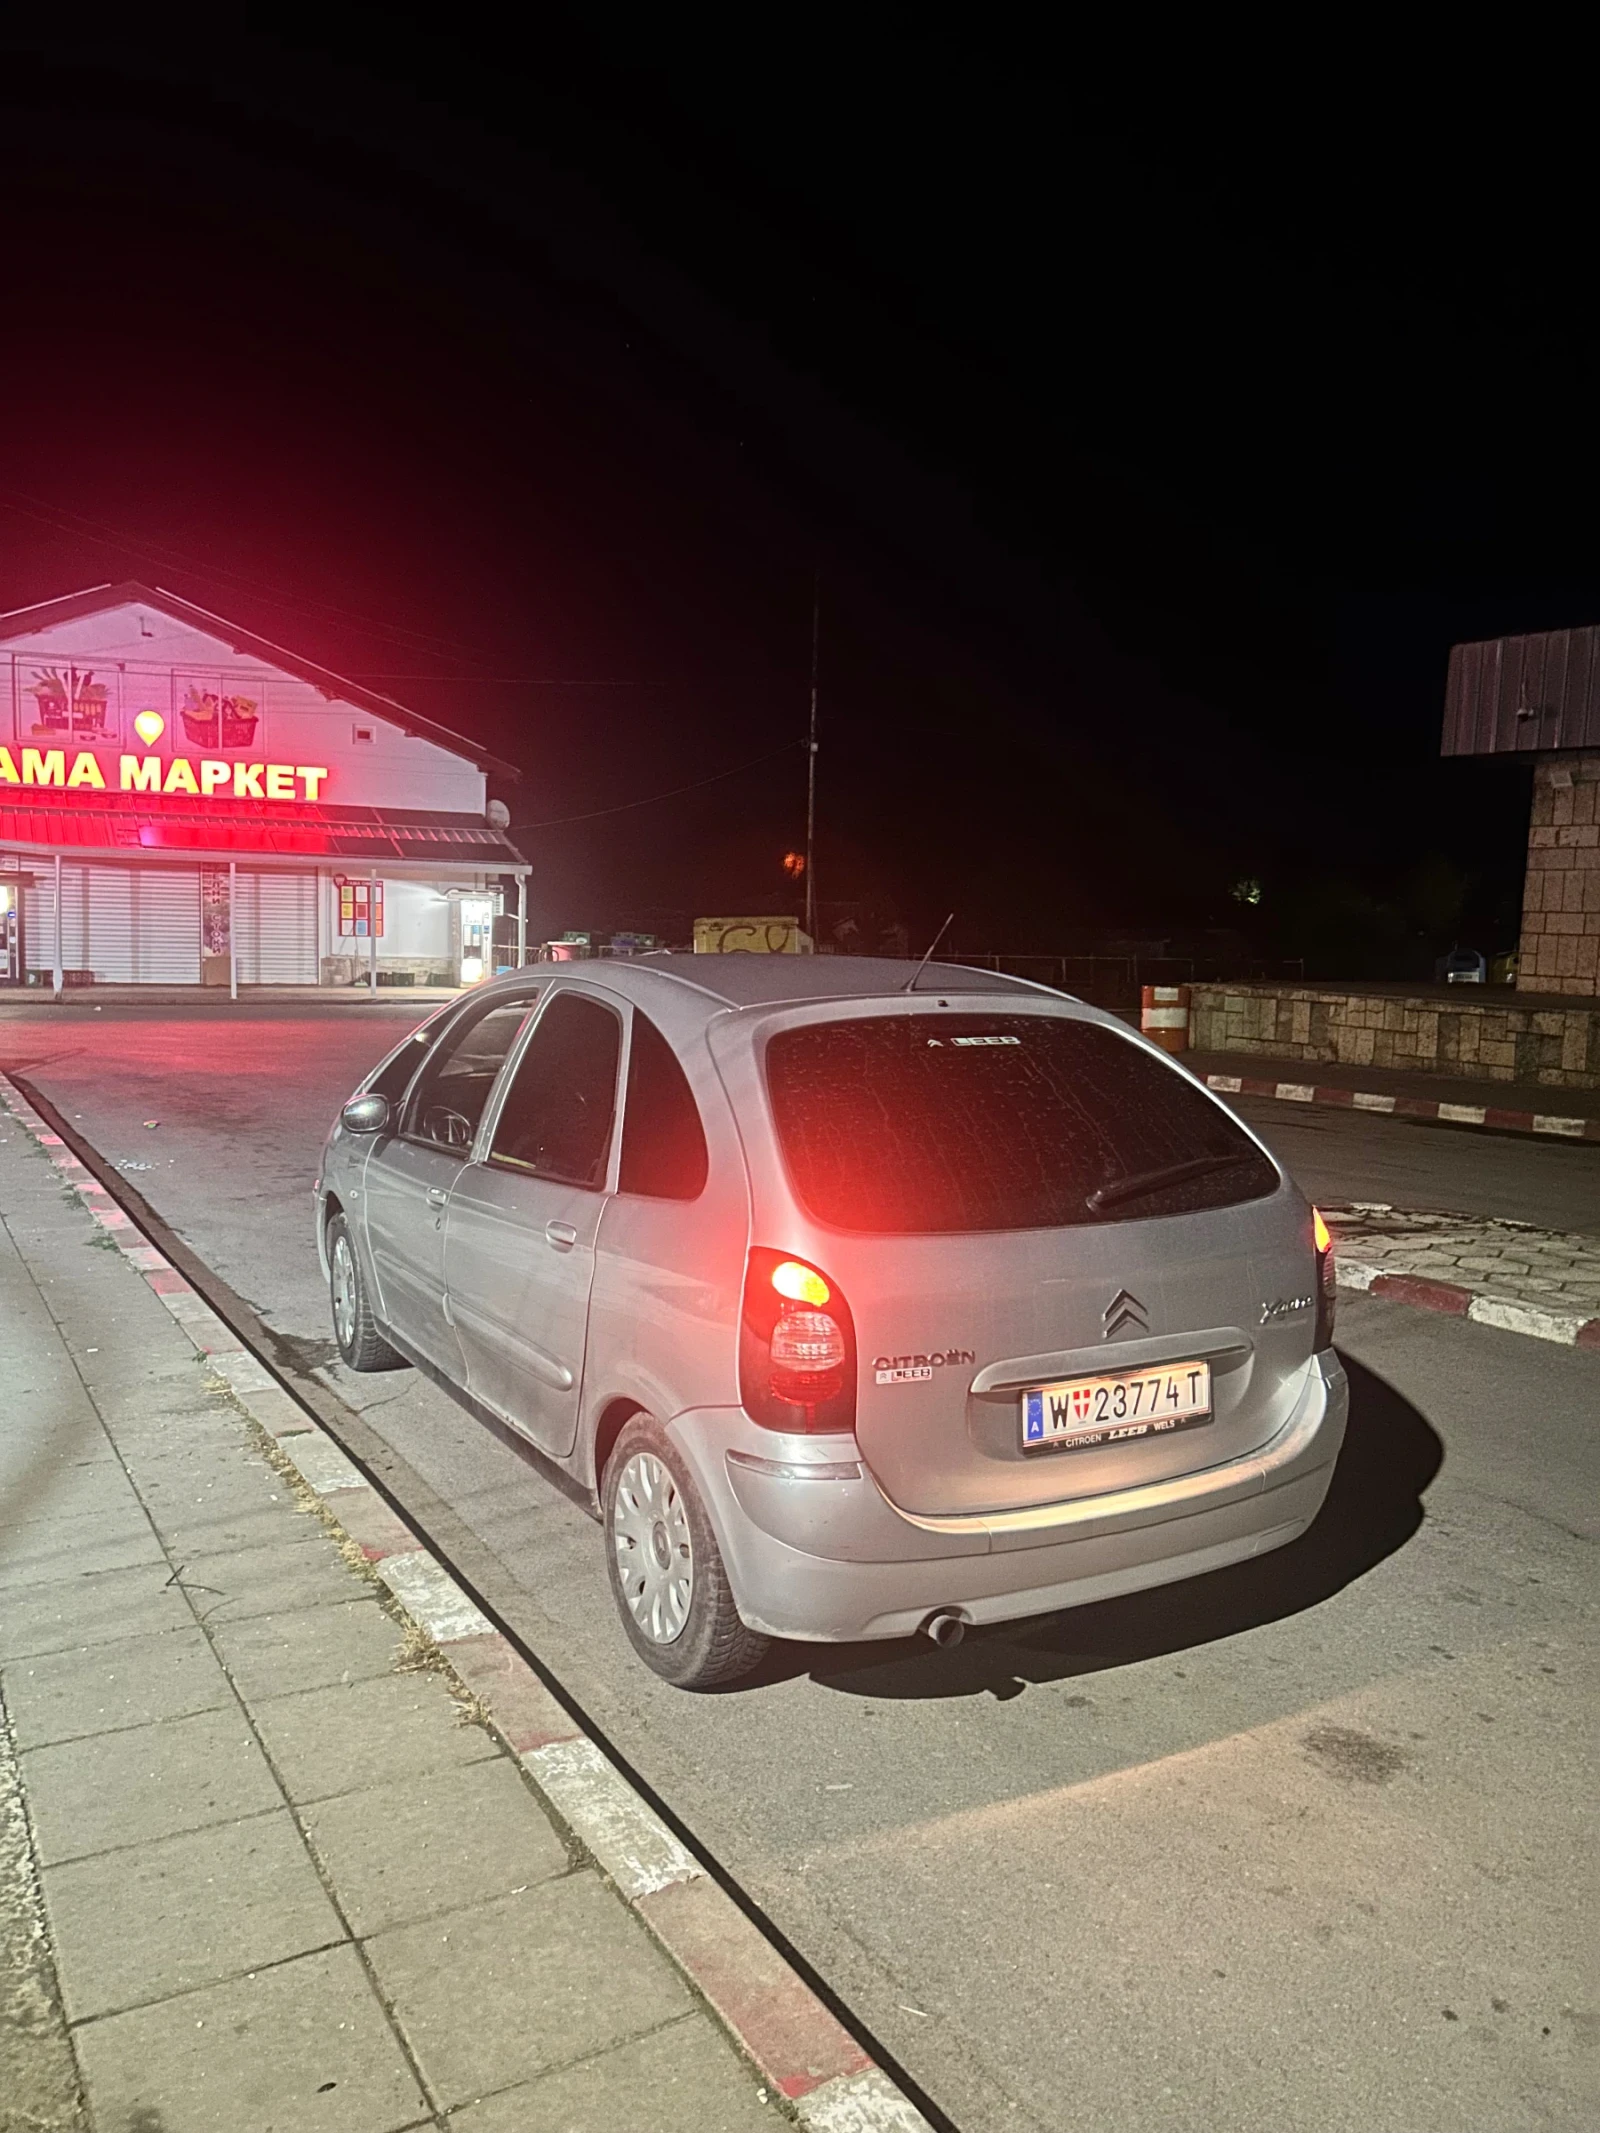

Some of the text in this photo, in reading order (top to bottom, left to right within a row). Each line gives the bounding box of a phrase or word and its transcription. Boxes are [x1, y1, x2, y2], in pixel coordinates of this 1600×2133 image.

[120, 755, 327, 800] МАРКЕТ
[872, 1349, 976, 1370] CITROËN
[1050, 1370, 1201, 1429] W 23774 T
[1031, 1422, 1039, 1433] A
[1066, 1419, 1175, 1448] CITROEN LEEB WELS
